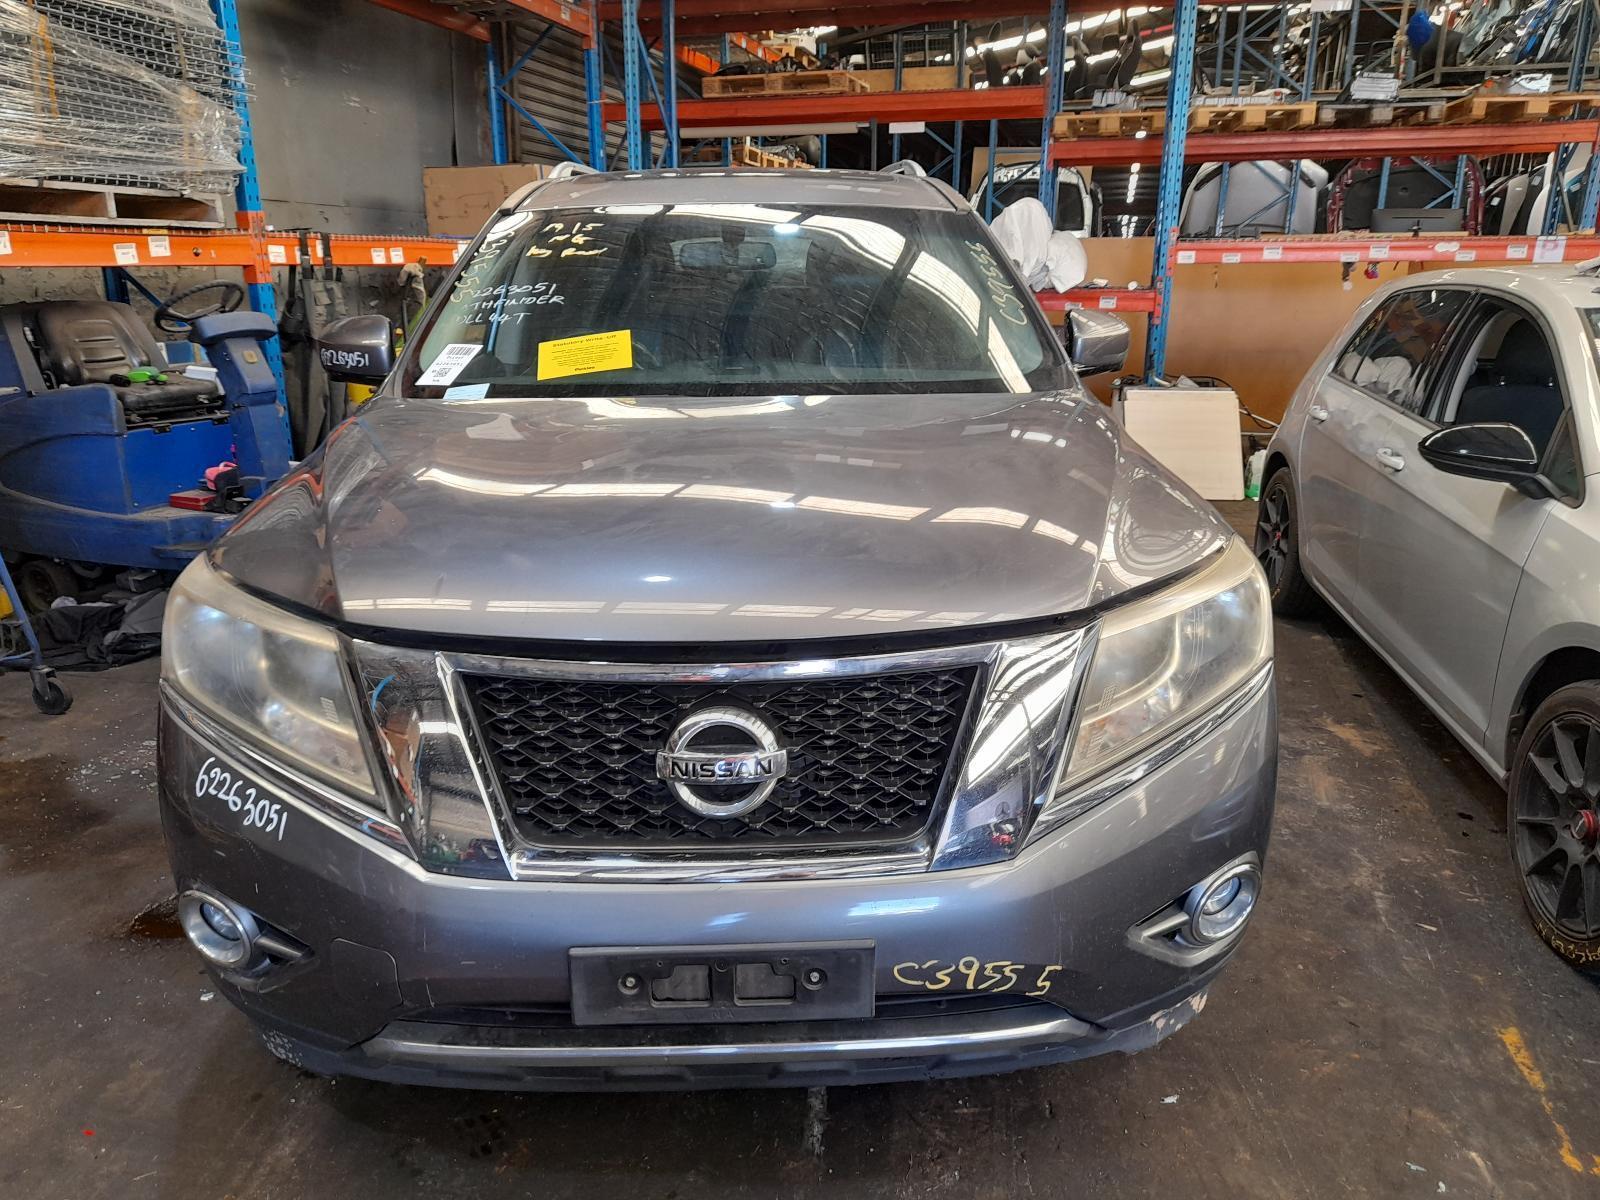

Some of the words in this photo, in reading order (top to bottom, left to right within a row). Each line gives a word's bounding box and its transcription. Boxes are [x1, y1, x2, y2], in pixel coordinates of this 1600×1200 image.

[472, 282, 556, 298] 2263051
[463, 295, 565, 310] THFINDER
[670, 758, 773, 779] NISSAN
[195, 756, 288, 841] 62263051
